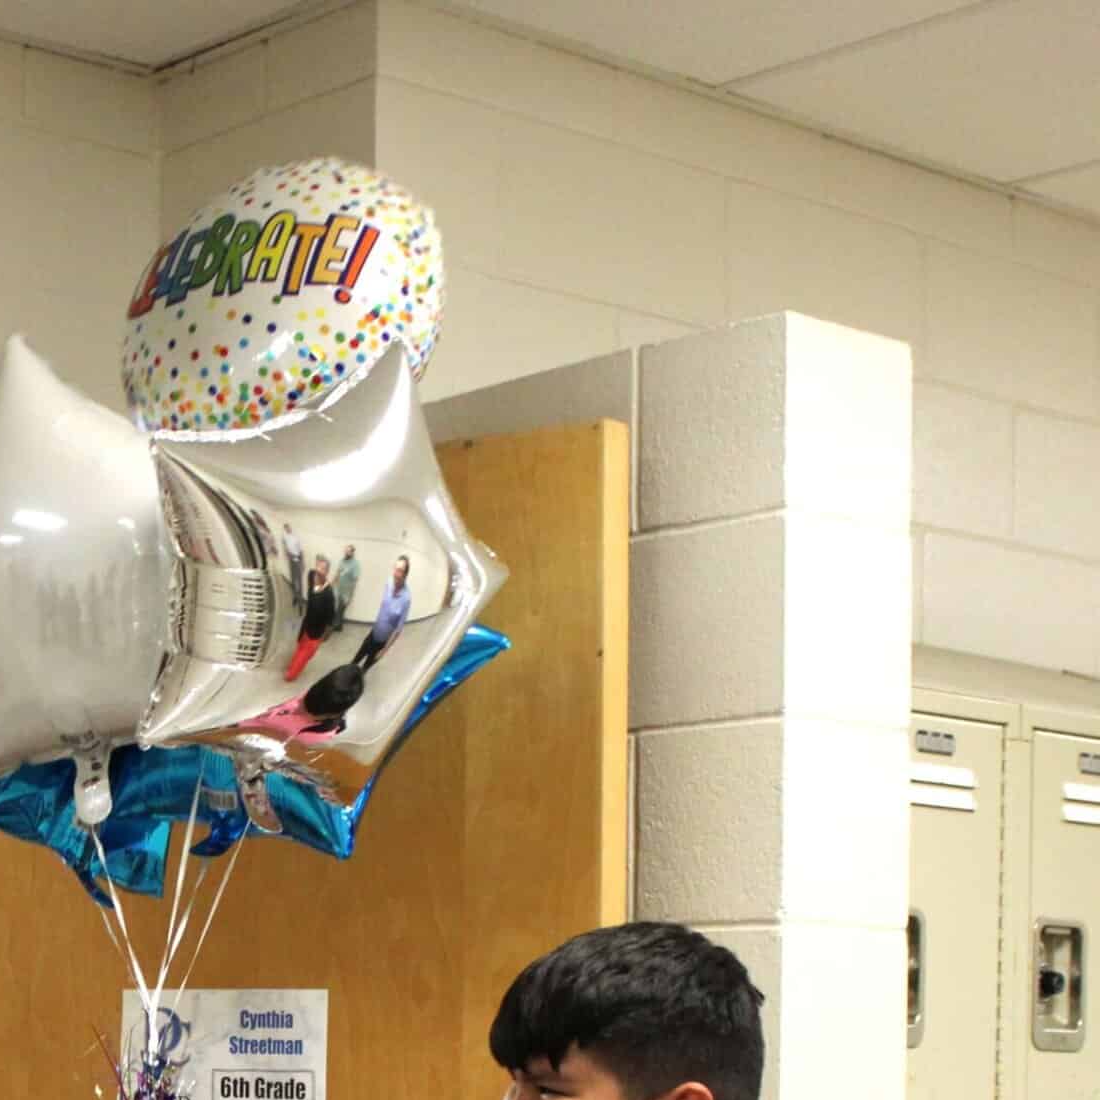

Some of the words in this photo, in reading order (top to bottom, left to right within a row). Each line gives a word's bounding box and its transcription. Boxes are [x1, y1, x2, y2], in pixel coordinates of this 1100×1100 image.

[239, 1009, 294, 1031] Cynthia
[228, 1036, 303, 1055] Streetman
[220, 1076, 250, 1099] 6th
[254, 1077, 306, 1100] Grade
